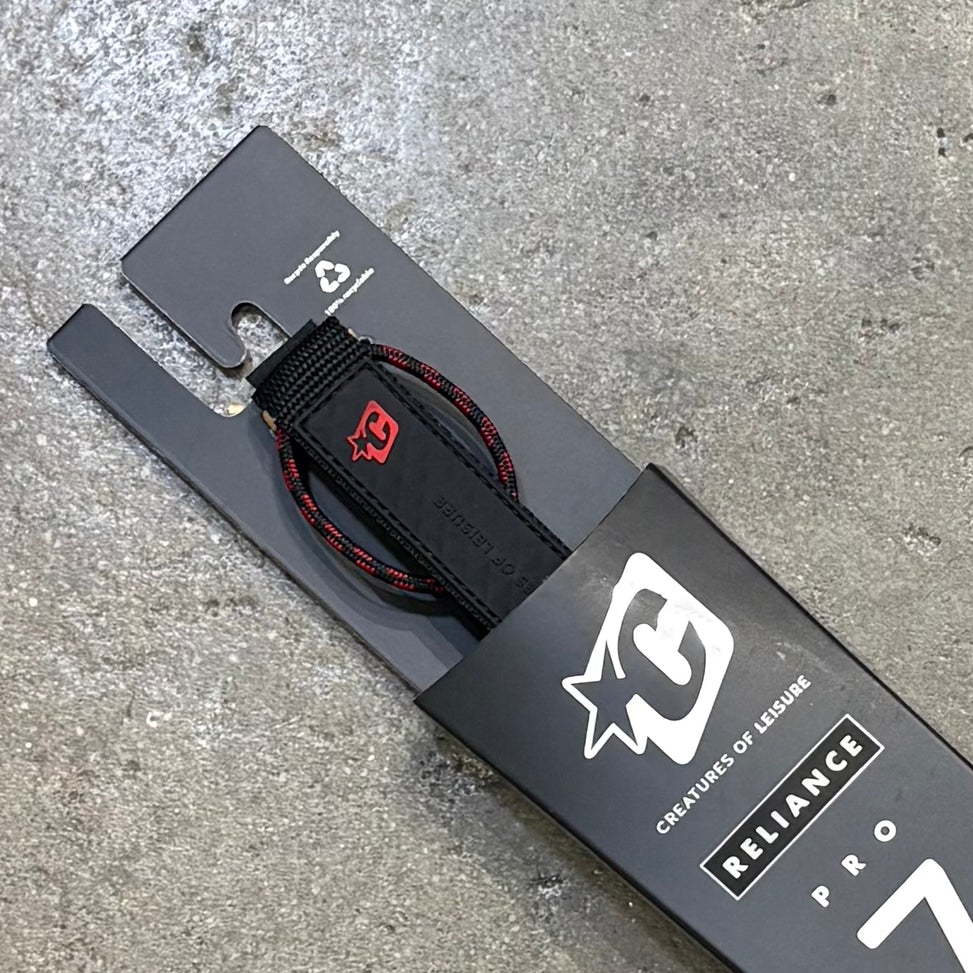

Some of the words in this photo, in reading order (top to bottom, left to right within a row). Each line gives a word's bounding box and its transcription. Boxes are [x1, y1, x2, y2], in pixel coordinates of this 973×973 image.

[432, 495, 496, 555] LEISURE
[655, 752, 735, 835] CREATURES
[732, 730, 754, 754] OF
[753, 674, 812, 735] LEISURE
[721, 734, 864, 880] RELIANCE
[810, 819, 898, 909] PRO
